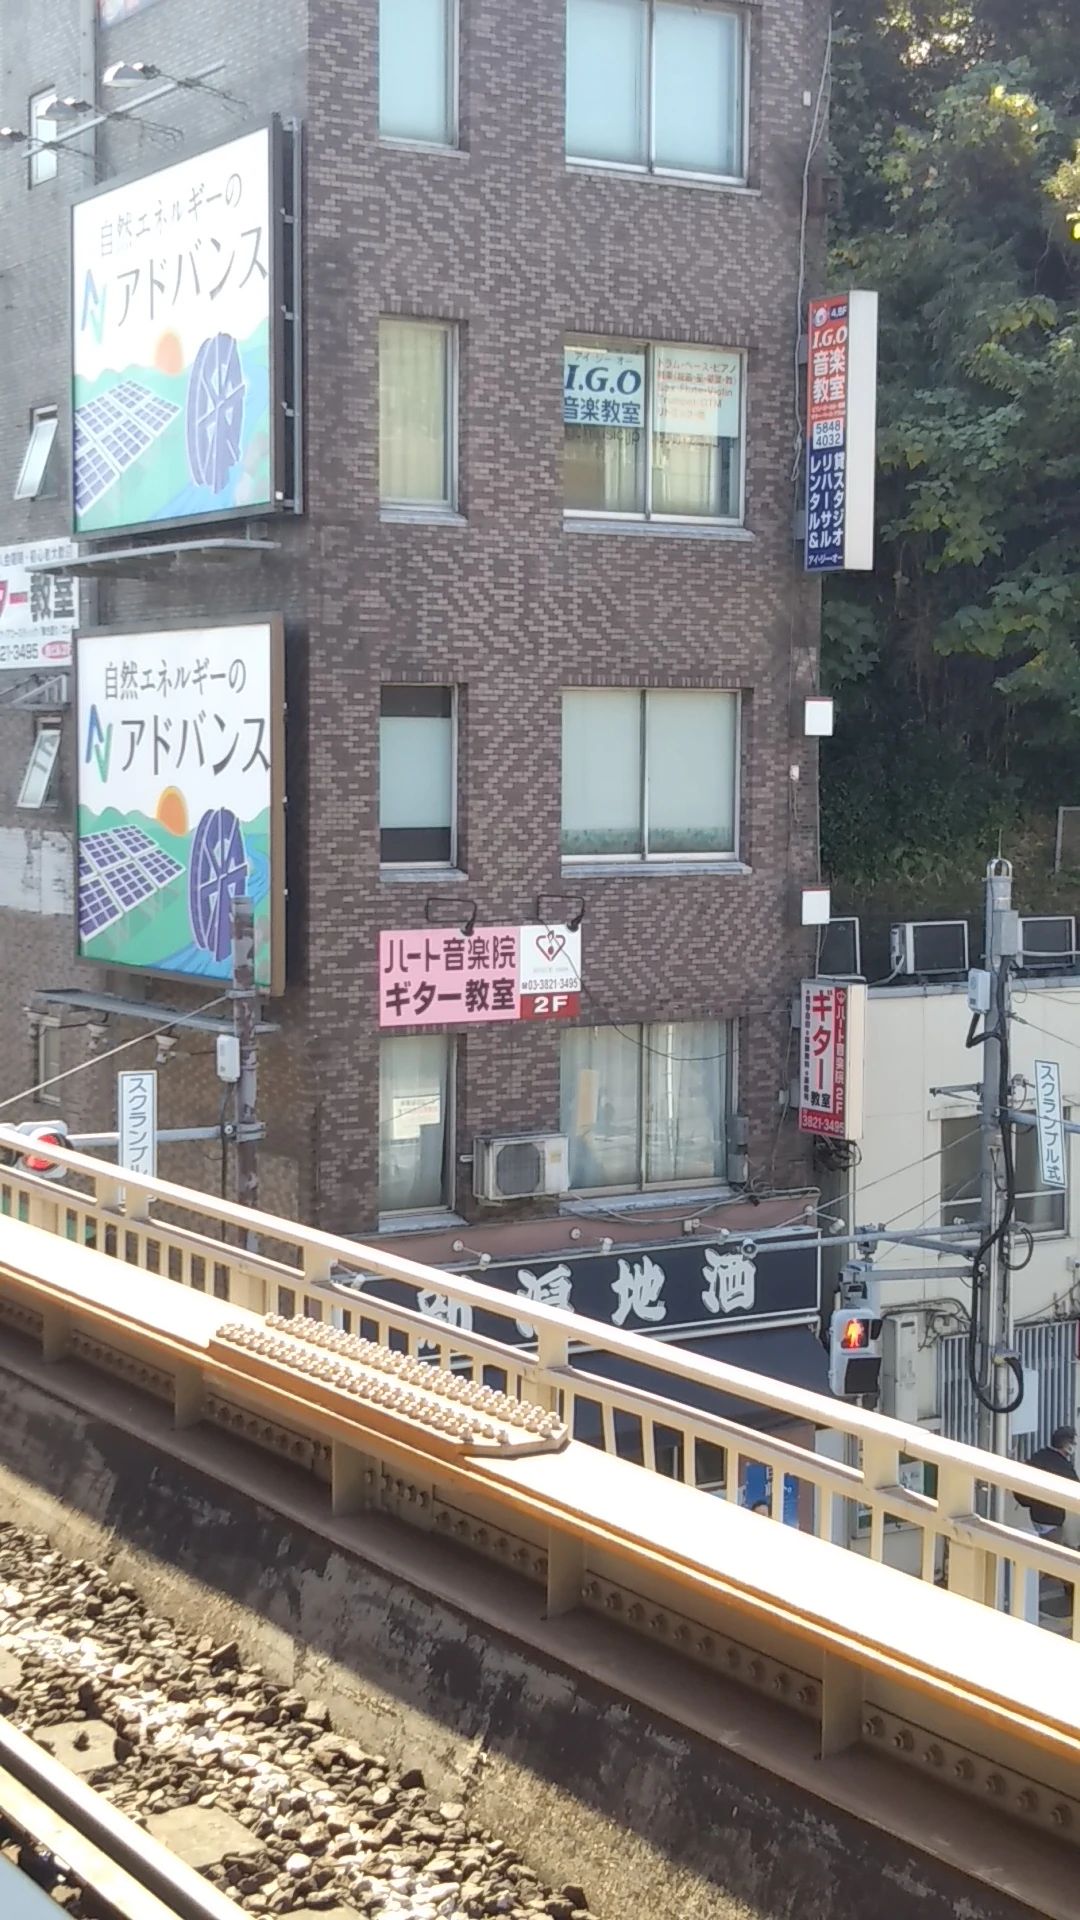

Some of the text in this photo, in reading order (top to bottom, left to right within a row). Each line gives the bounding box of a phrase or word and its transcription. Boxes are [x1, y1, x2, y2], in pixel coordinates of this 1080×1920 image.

[101, 173, 242, 257] 自然エネルギーの
[117, 227, 268, 327] アドバンス
[812, 325, 848, 349] I.G.O
[813, 347, 845, 377] 音楽
[565, 364, 641, 395] I.G.O
[812, 375, 846, 404] 教室
[564, 396, 641, 425] 音楽教室
[815, 420, 841, 435] 5848
[816, 433, 841, 446] 4032
[820, 452, 833, 548] リハーサル
[832, 452, 845, 547] 貸スタジオ
[105, 658, 247, 700] 自然エネルギーの
[121, 711, 271, 776] アドバンス
[384, 935, 516, 973] ハート音楽院
[386, 977, 516, 1017] ギター教室
[534, 995, 567, 1013] 2F
[812, 990, 833, 1090] ギター
[810, 1091, 831, 1108] 教室
[802, 1114, 845, 1134] 3821-3495
